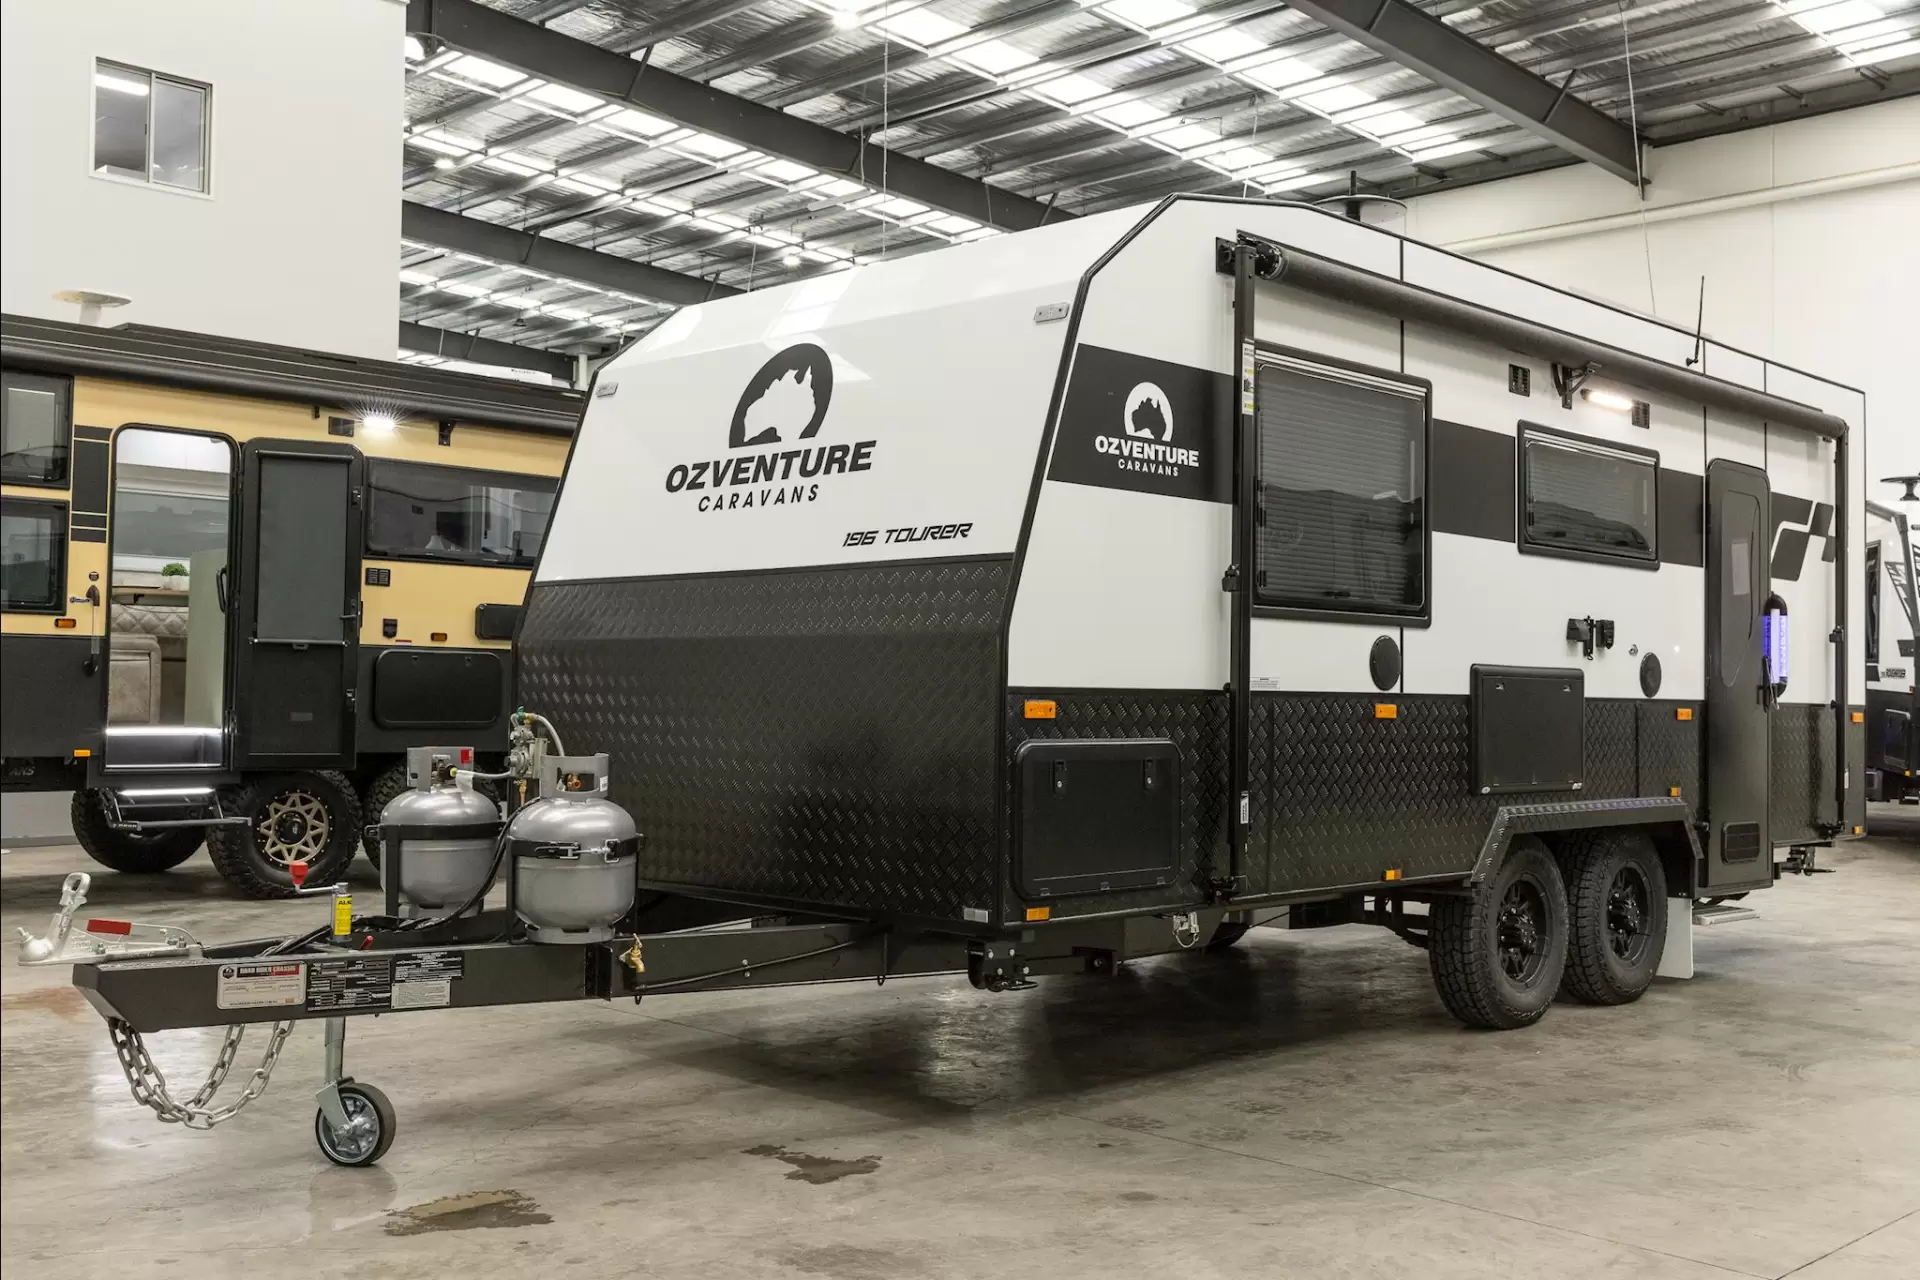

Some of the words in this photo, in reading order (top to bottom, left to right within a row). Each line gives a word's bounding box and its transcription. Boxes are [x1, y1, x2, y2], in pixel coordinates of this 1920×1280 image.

[1095, 435, 1199, 467] OZVENTURE
[665, 440, 877, 493] OZVENTURE
[1118, 459, 1179, 477] CARAVANS
[698, 484, 819, 512] CARAVANS
[842, 530, 879, 547] 196
[884, 522, 973, 545] TOURER
